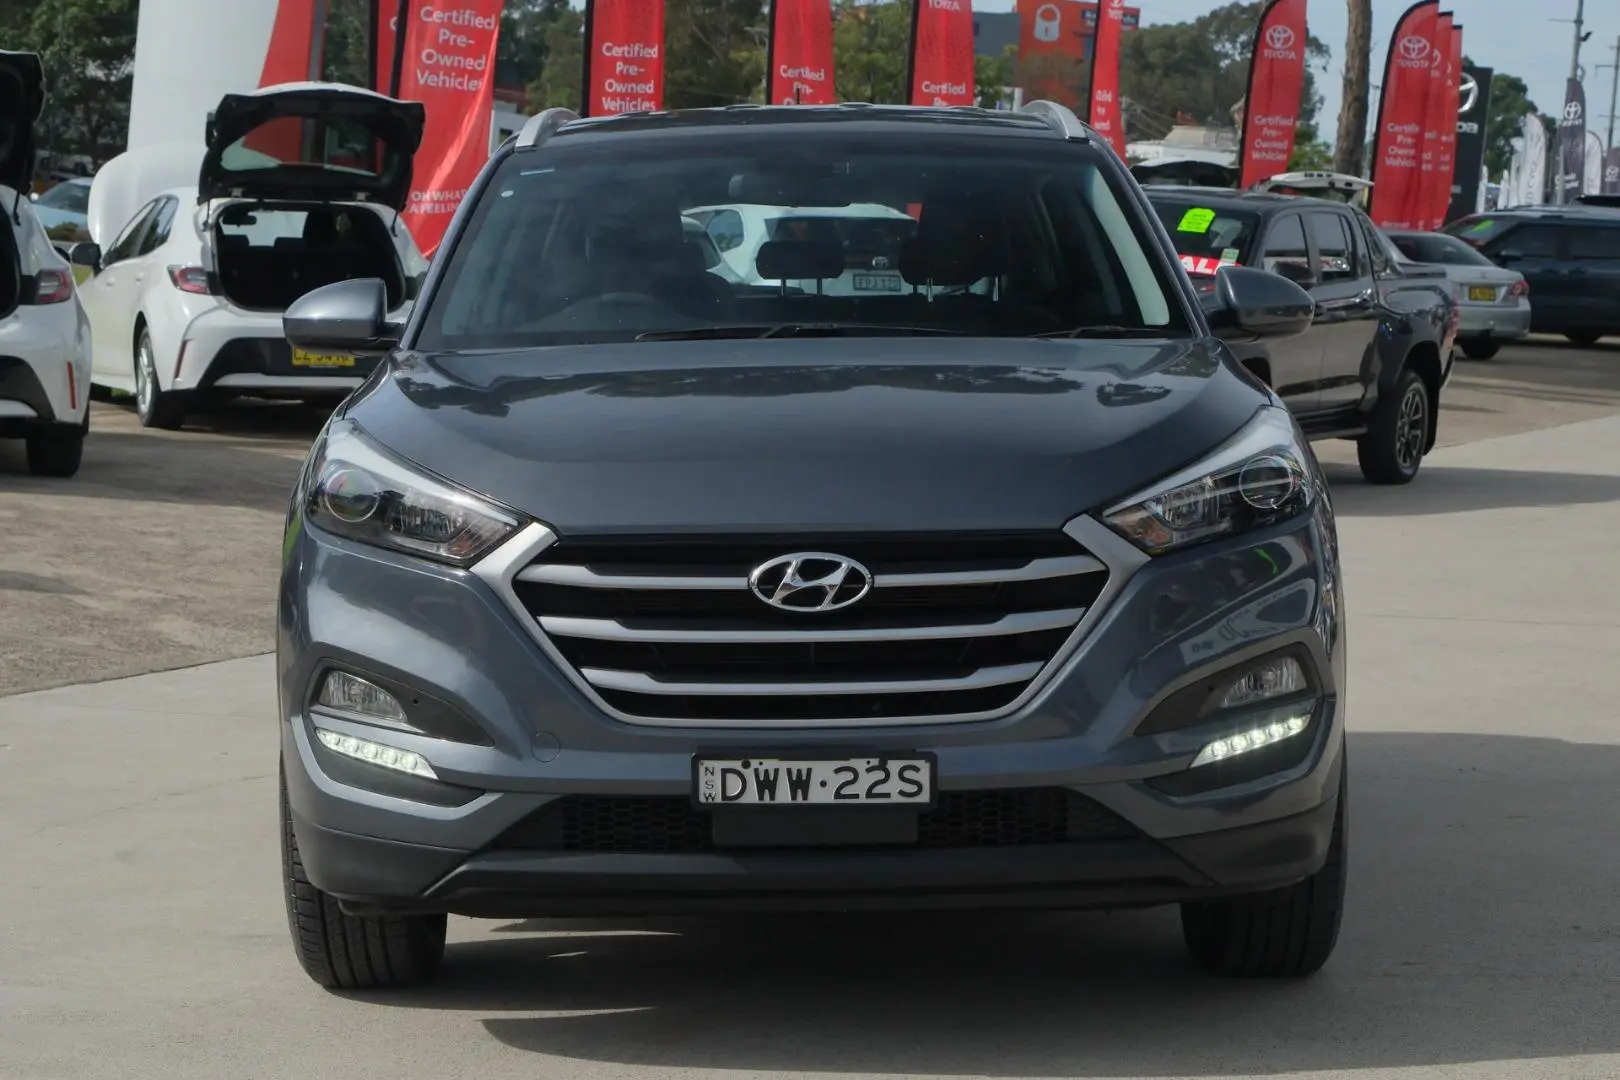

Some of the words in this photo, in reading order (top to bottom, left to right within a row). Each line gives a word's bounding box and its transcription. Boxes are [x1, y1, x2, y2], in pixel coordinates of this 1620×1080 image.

[420, 5, 496, 30] Certified
[439, 28, 475, 47] Pre-
[602, 42, 659, 58] Certified
[1264, 49, 1297, 60] TOYOTA
[421, 48, 486, 71] Owned
[615, 61, 646, 76] Pre-
[604, 79, 655, 94] Owned
[602, 96, 656, 113] Vehicles
[1254, 114, 1294, 126] Certified
